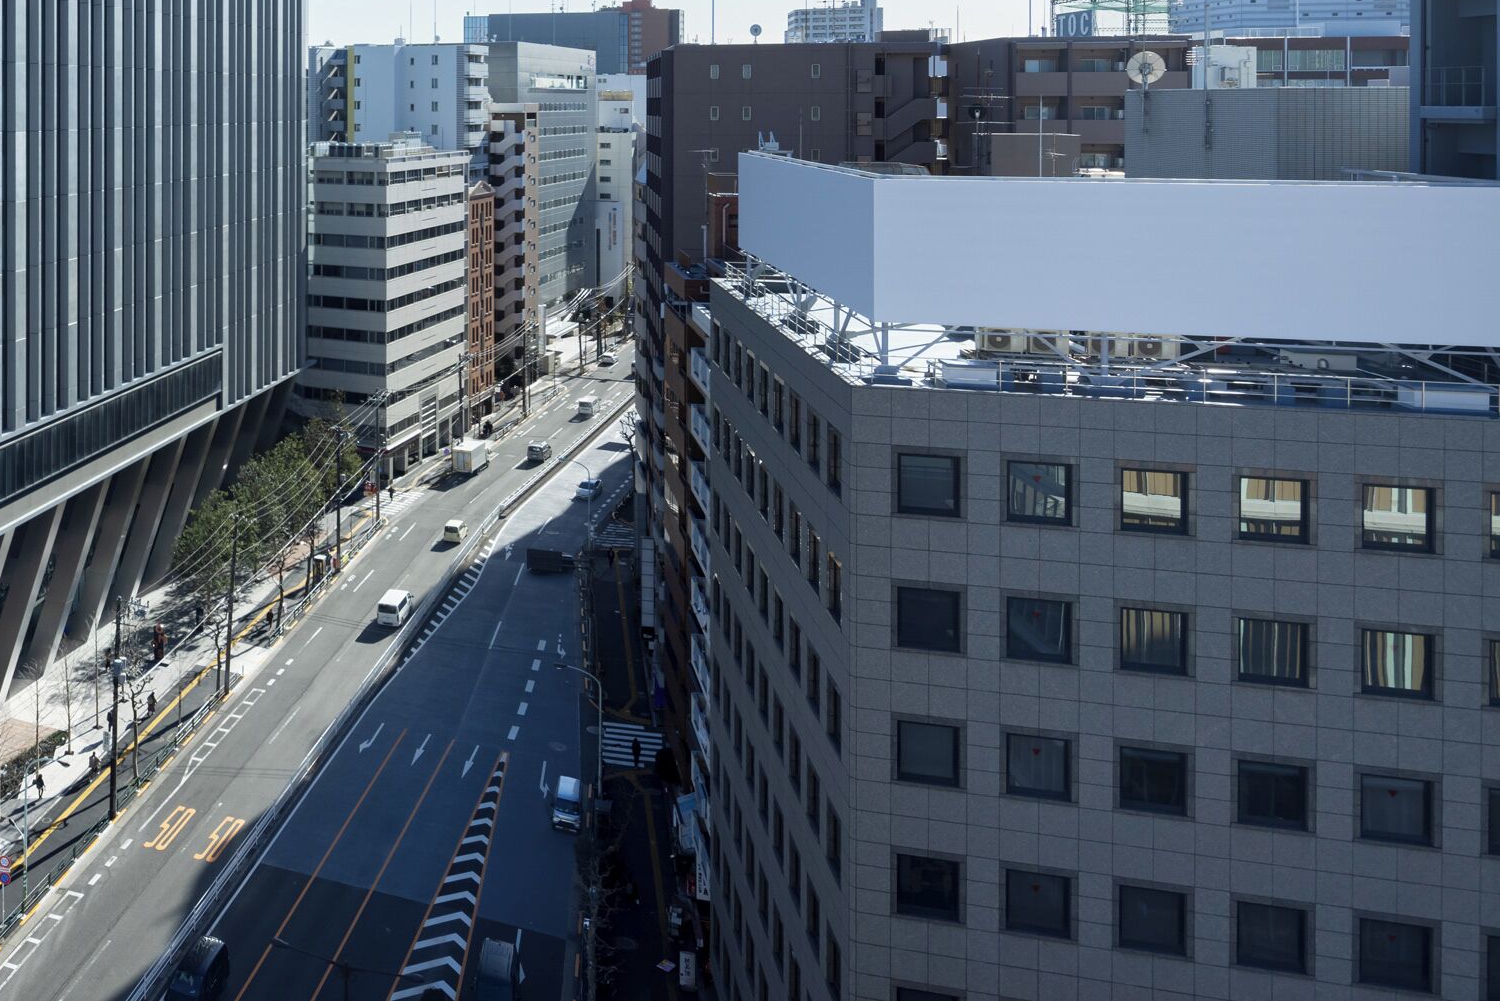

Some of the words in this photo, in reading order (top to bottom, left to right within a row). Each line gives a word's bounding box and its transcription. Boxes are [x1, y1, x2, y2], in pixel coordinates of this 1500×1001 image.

[1058, 13, 1089, 36] TOC
[143, 806, 196, 850] 50
[194, 817, 245, 862] 50
